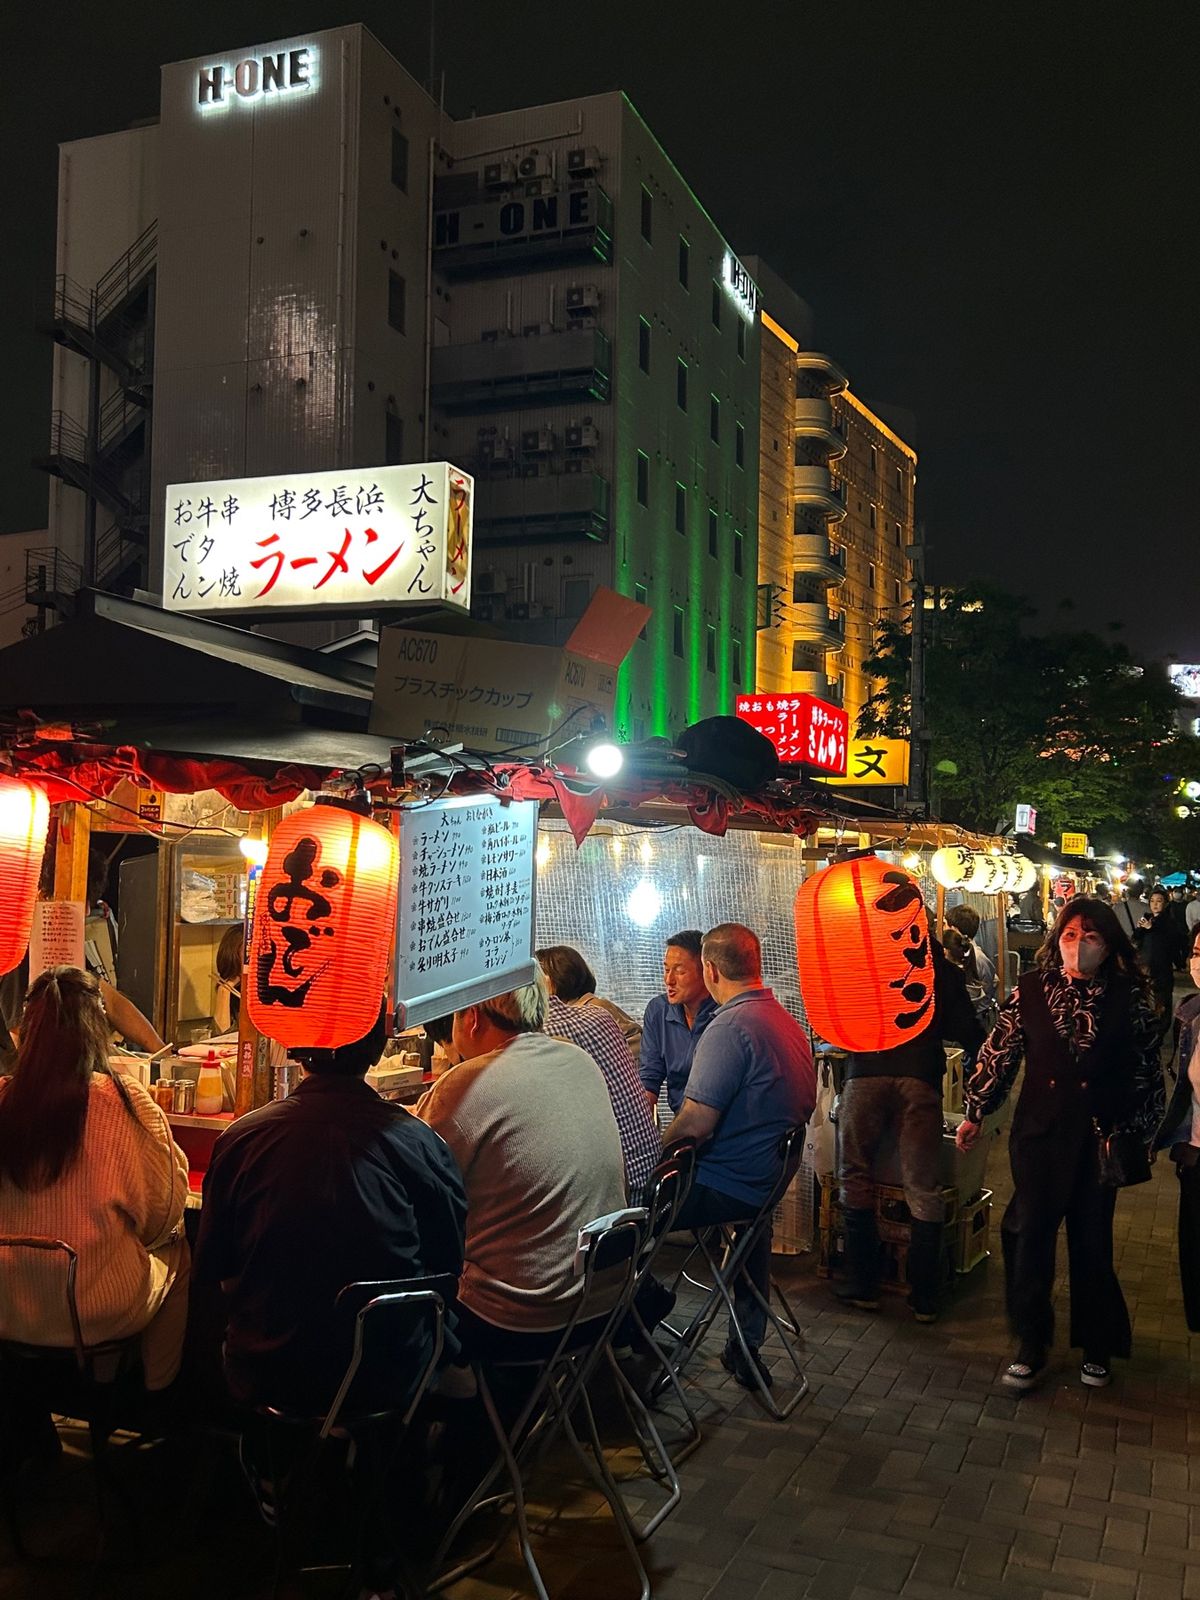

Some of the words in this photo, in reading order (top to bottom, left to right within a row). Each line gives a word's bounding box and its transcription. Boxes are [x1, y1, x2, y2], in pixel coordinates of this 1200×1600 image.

[198, 48, 312, 105] H-ONE
[268, 483, 385, 521] 博多長浜
[172, 498, 196, 600] おでん
[407, 474, 438, 594] 大ちゃん
[450, 479, 466, 595] ラーメン
[249, 527, 405, 600] ラーメン
[398, 636, 439, 664] AC670
[393, 674, 534, 709] プラスチックカップ
[776, 699, 789, 757] 焼ラーメン
[789, 699, 801, 757] ラーメン
[419, 842, 465, 862] チャーシューメン
[421, 830, 449, 846] ラーメン
[418, 860, 457, 879] 焼ラーメン
[486, 867, 508, 882] 日本酒
[257, 837, 340, 1008] おでん
[418, 895, 449, 916] 牛サガリ
[874, 871, 934, 1030] ラーメン
